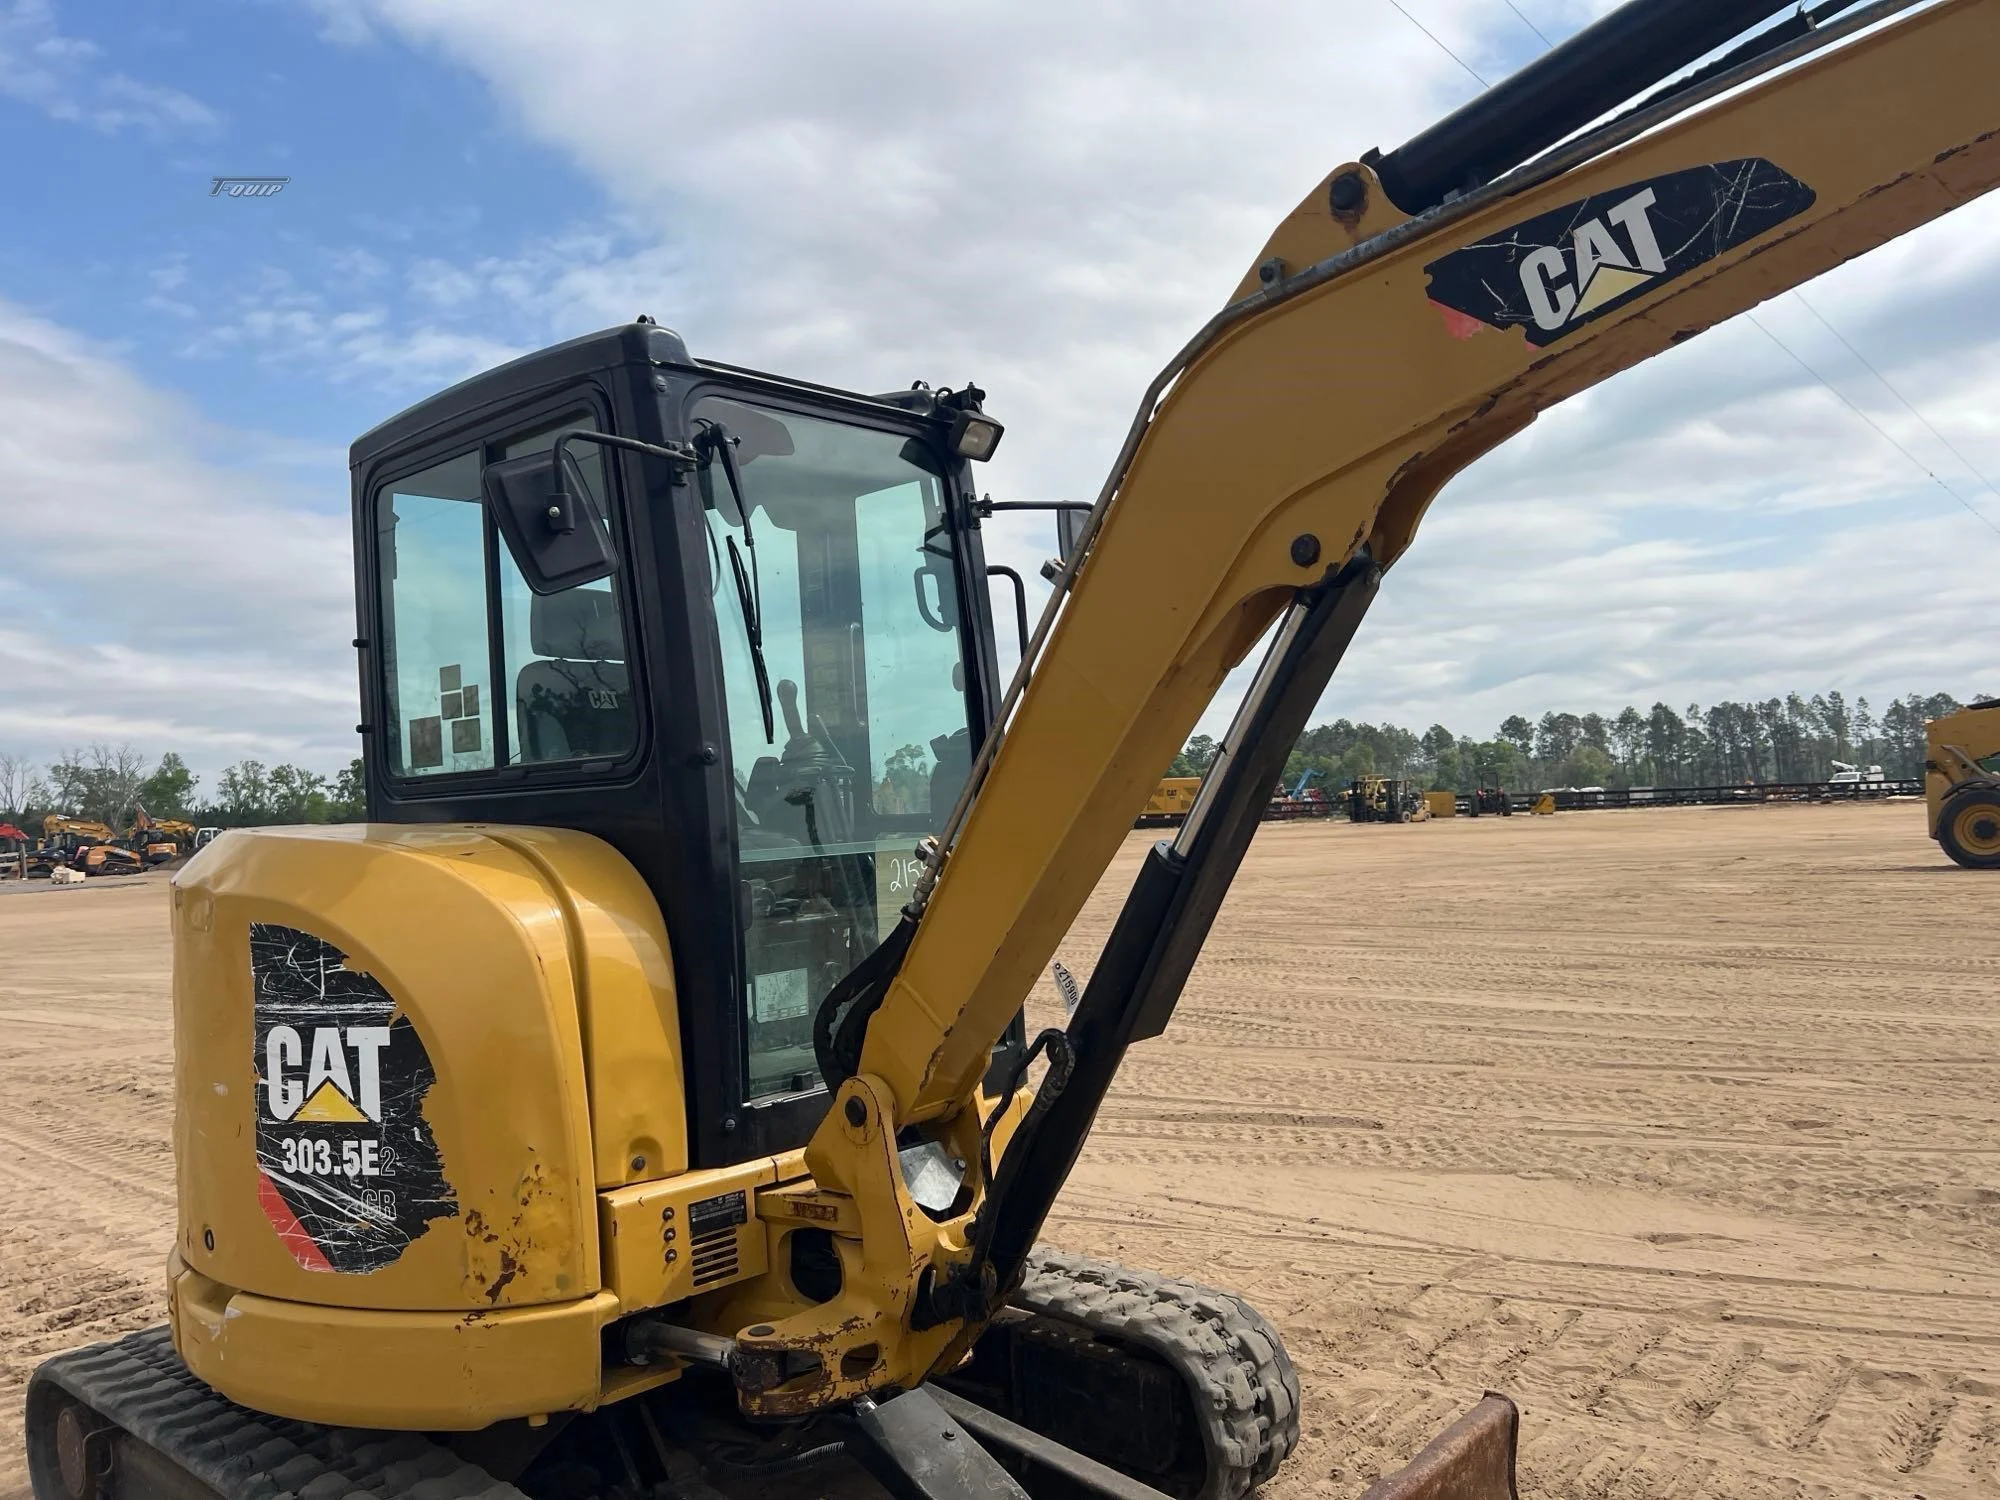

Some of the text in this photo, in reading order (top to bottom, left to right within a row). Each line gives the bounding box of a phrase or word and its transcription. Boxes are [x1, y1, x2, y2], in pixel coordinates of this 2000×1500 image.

[1519, 187, 1666, 330] CAT
[588, 690, 619, 709] CAT
[1058, 969, 1079, 1006] 215900
[266, 1025, 391, 1122] CAT
